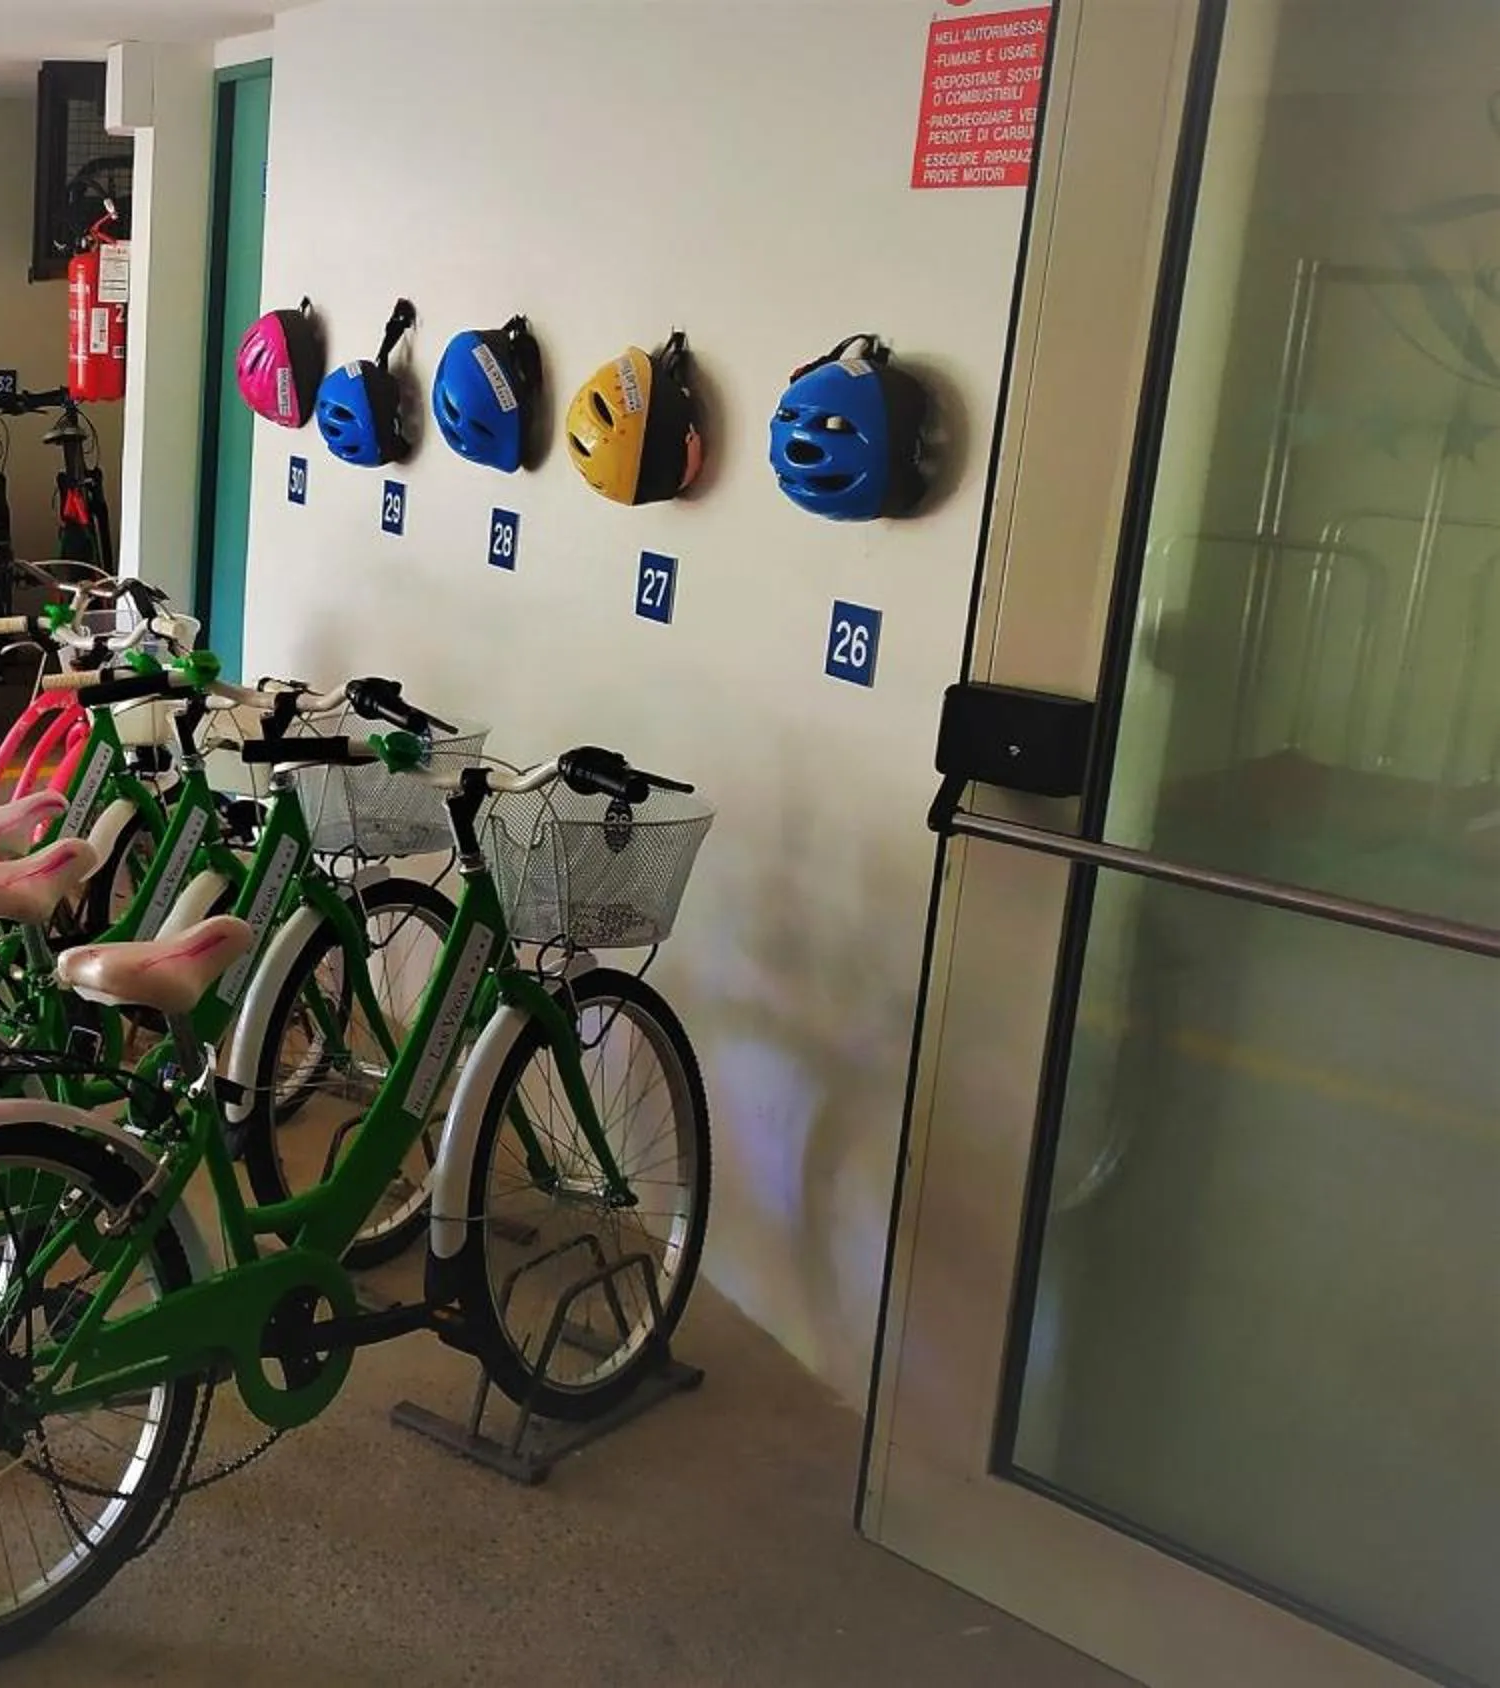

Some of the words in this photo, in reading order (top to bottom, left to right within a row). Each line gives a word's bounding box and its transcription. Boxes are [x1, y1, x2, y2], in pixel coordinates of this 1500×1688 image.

[986, 47, 996, 62] E
[1000, 43, 1038, 61] USARE
[933, 93, 941, 106] O
[945, 86, 1024, 105] COMBUSTIBILI
[928, 128, 975, 145] PERDITE
[977, 128, 989, 142] DI
[923, 168, 959, 183] PROVE
[963, 167, 1005, 182] MOTORI
[291, 466, 304, 495] 30
[385, 492, 401, 523] 29
[493, 523, 513, 557] 28
[641, 567, 669, 608] 27
[833, 620, 869, 667] 26
